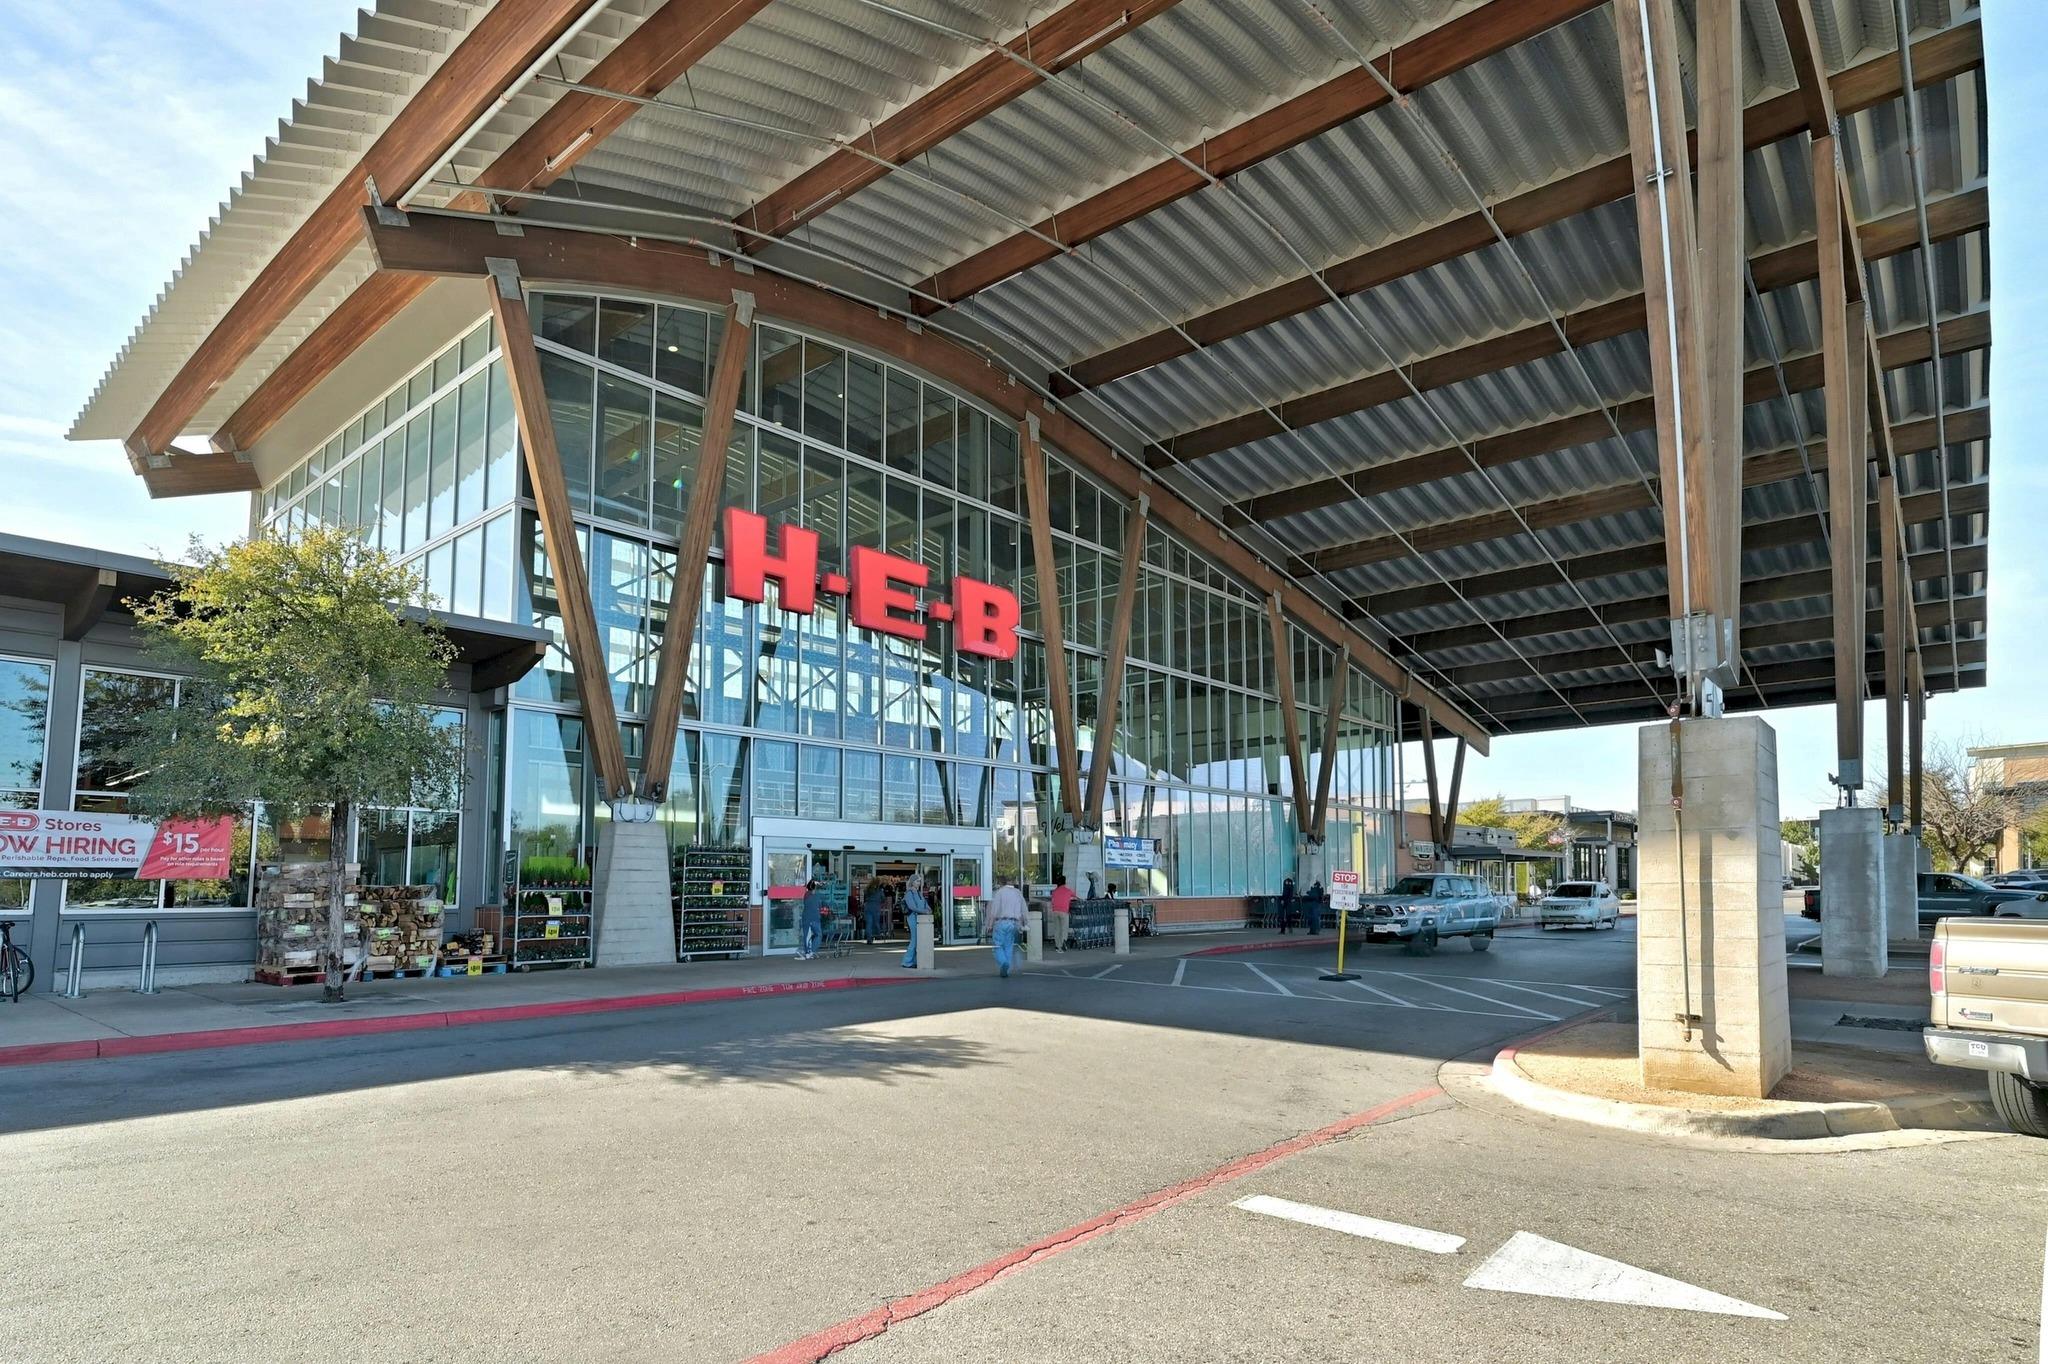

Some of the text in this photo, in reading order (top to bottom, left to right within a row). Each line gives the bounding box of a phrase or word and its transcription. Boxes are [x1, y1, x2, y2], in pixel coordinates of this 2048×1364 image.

[723, 506, 1019, 661] H-E-B
[45, 818, 102, 832] Stores
[46, 836, 136, 855] HIRING
[162, 831, 200, 854] $15
[3, 870, 78, 878] Careers.heb.com
[90, 871, 114, 880] apply
[1334, 873, 1357, 882] STOP
[1971, 1043, 1986, 1051] TCU
